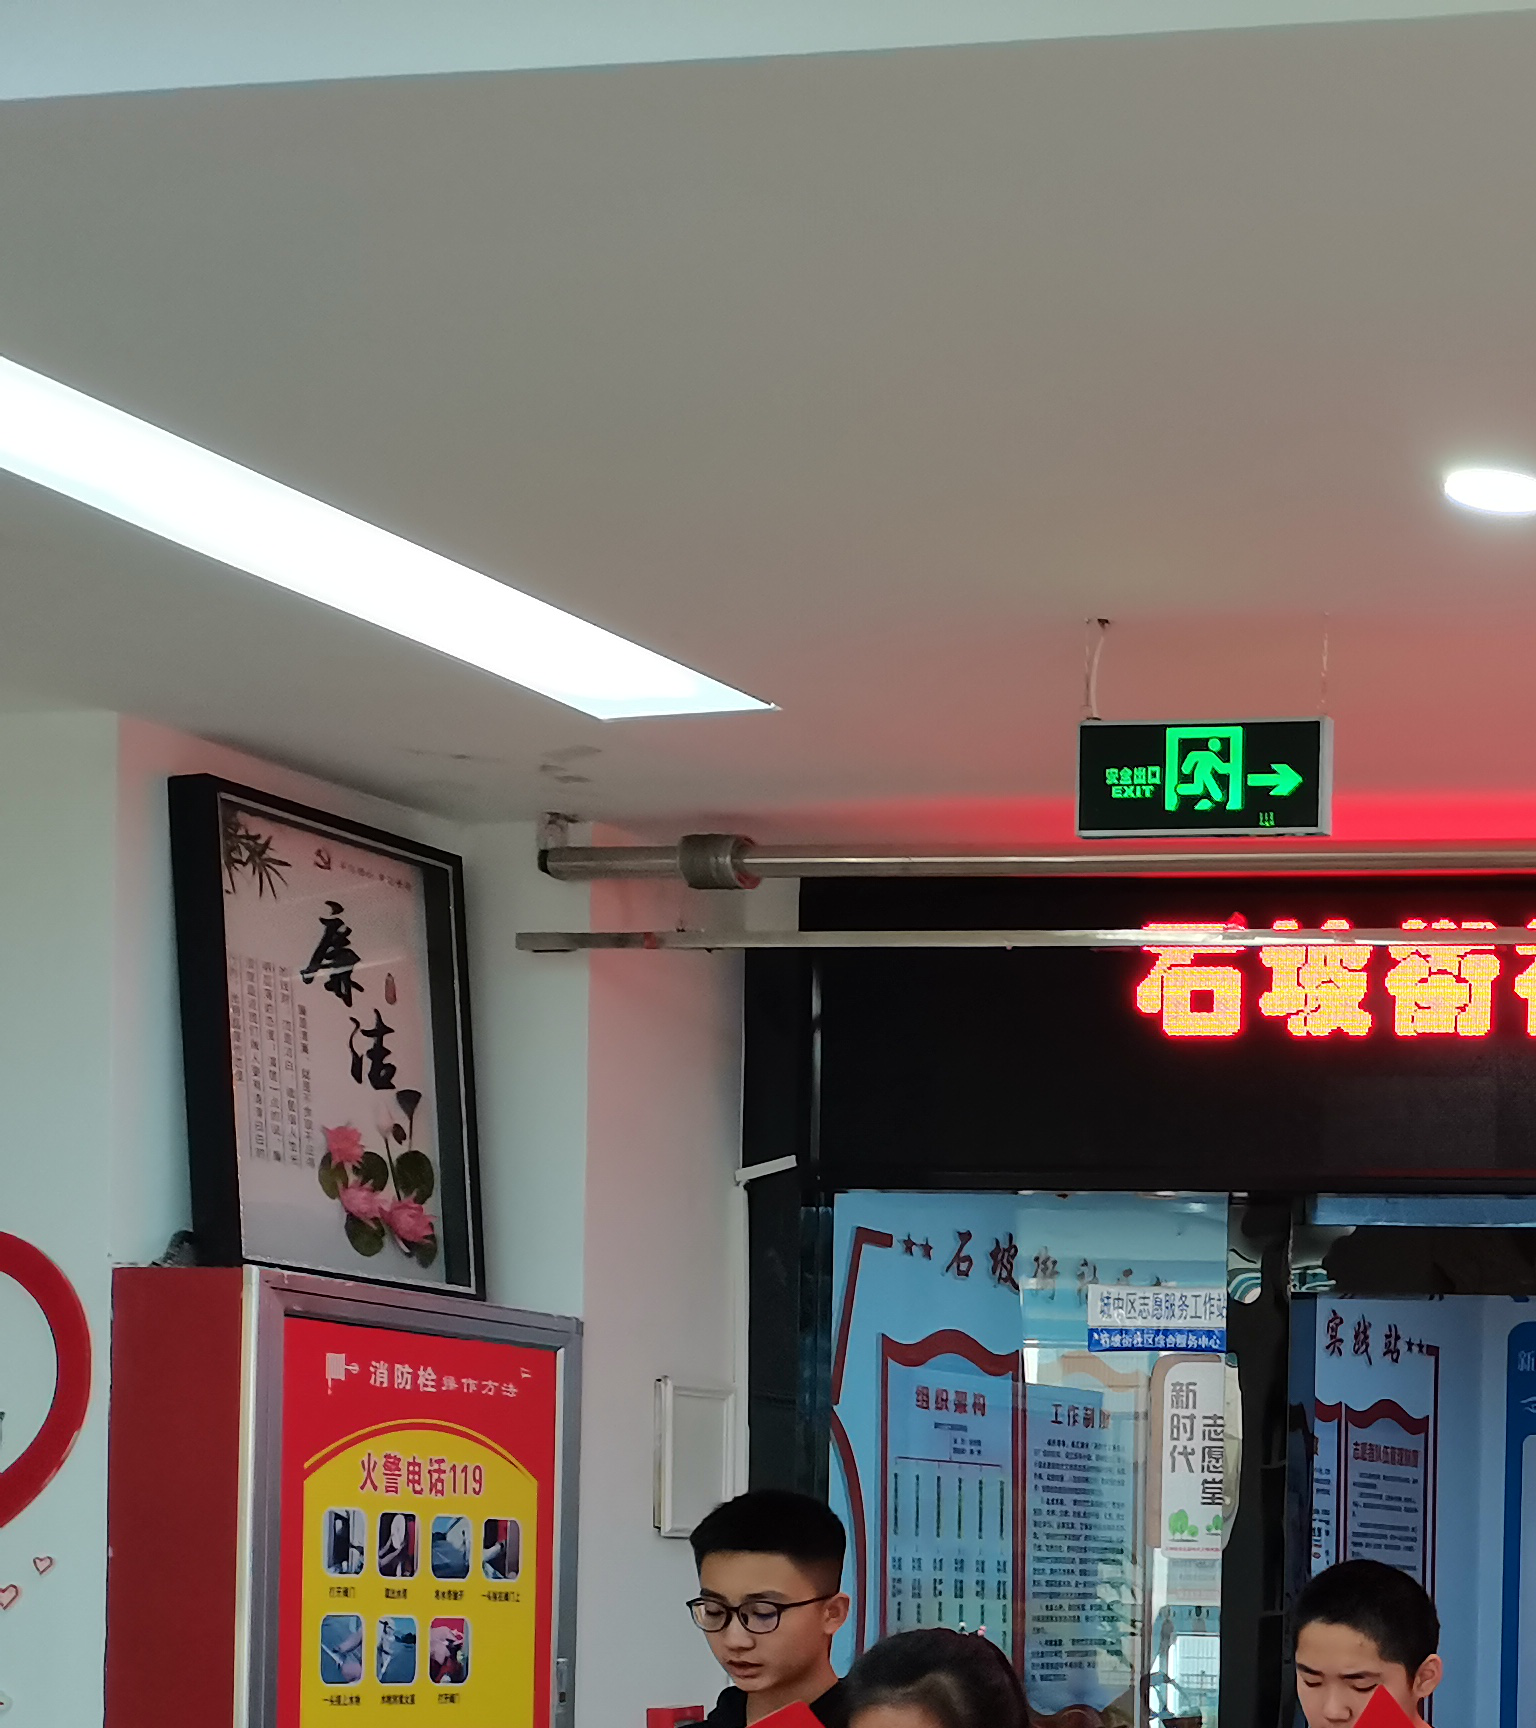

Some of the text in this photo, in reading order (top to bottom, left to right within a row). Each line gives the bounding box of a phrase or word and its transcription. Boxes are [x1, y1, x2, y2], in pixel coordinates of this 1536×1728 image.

[1105, 765, 1161, 786] 安全出口
[1111, 785, 1155, 799] EXIT
[300, 900, 398, 1092] 廉洁
[1169, 1381, 1198, 1474] 新时代
[359, 1451, 484, 1498] 火警电话119
